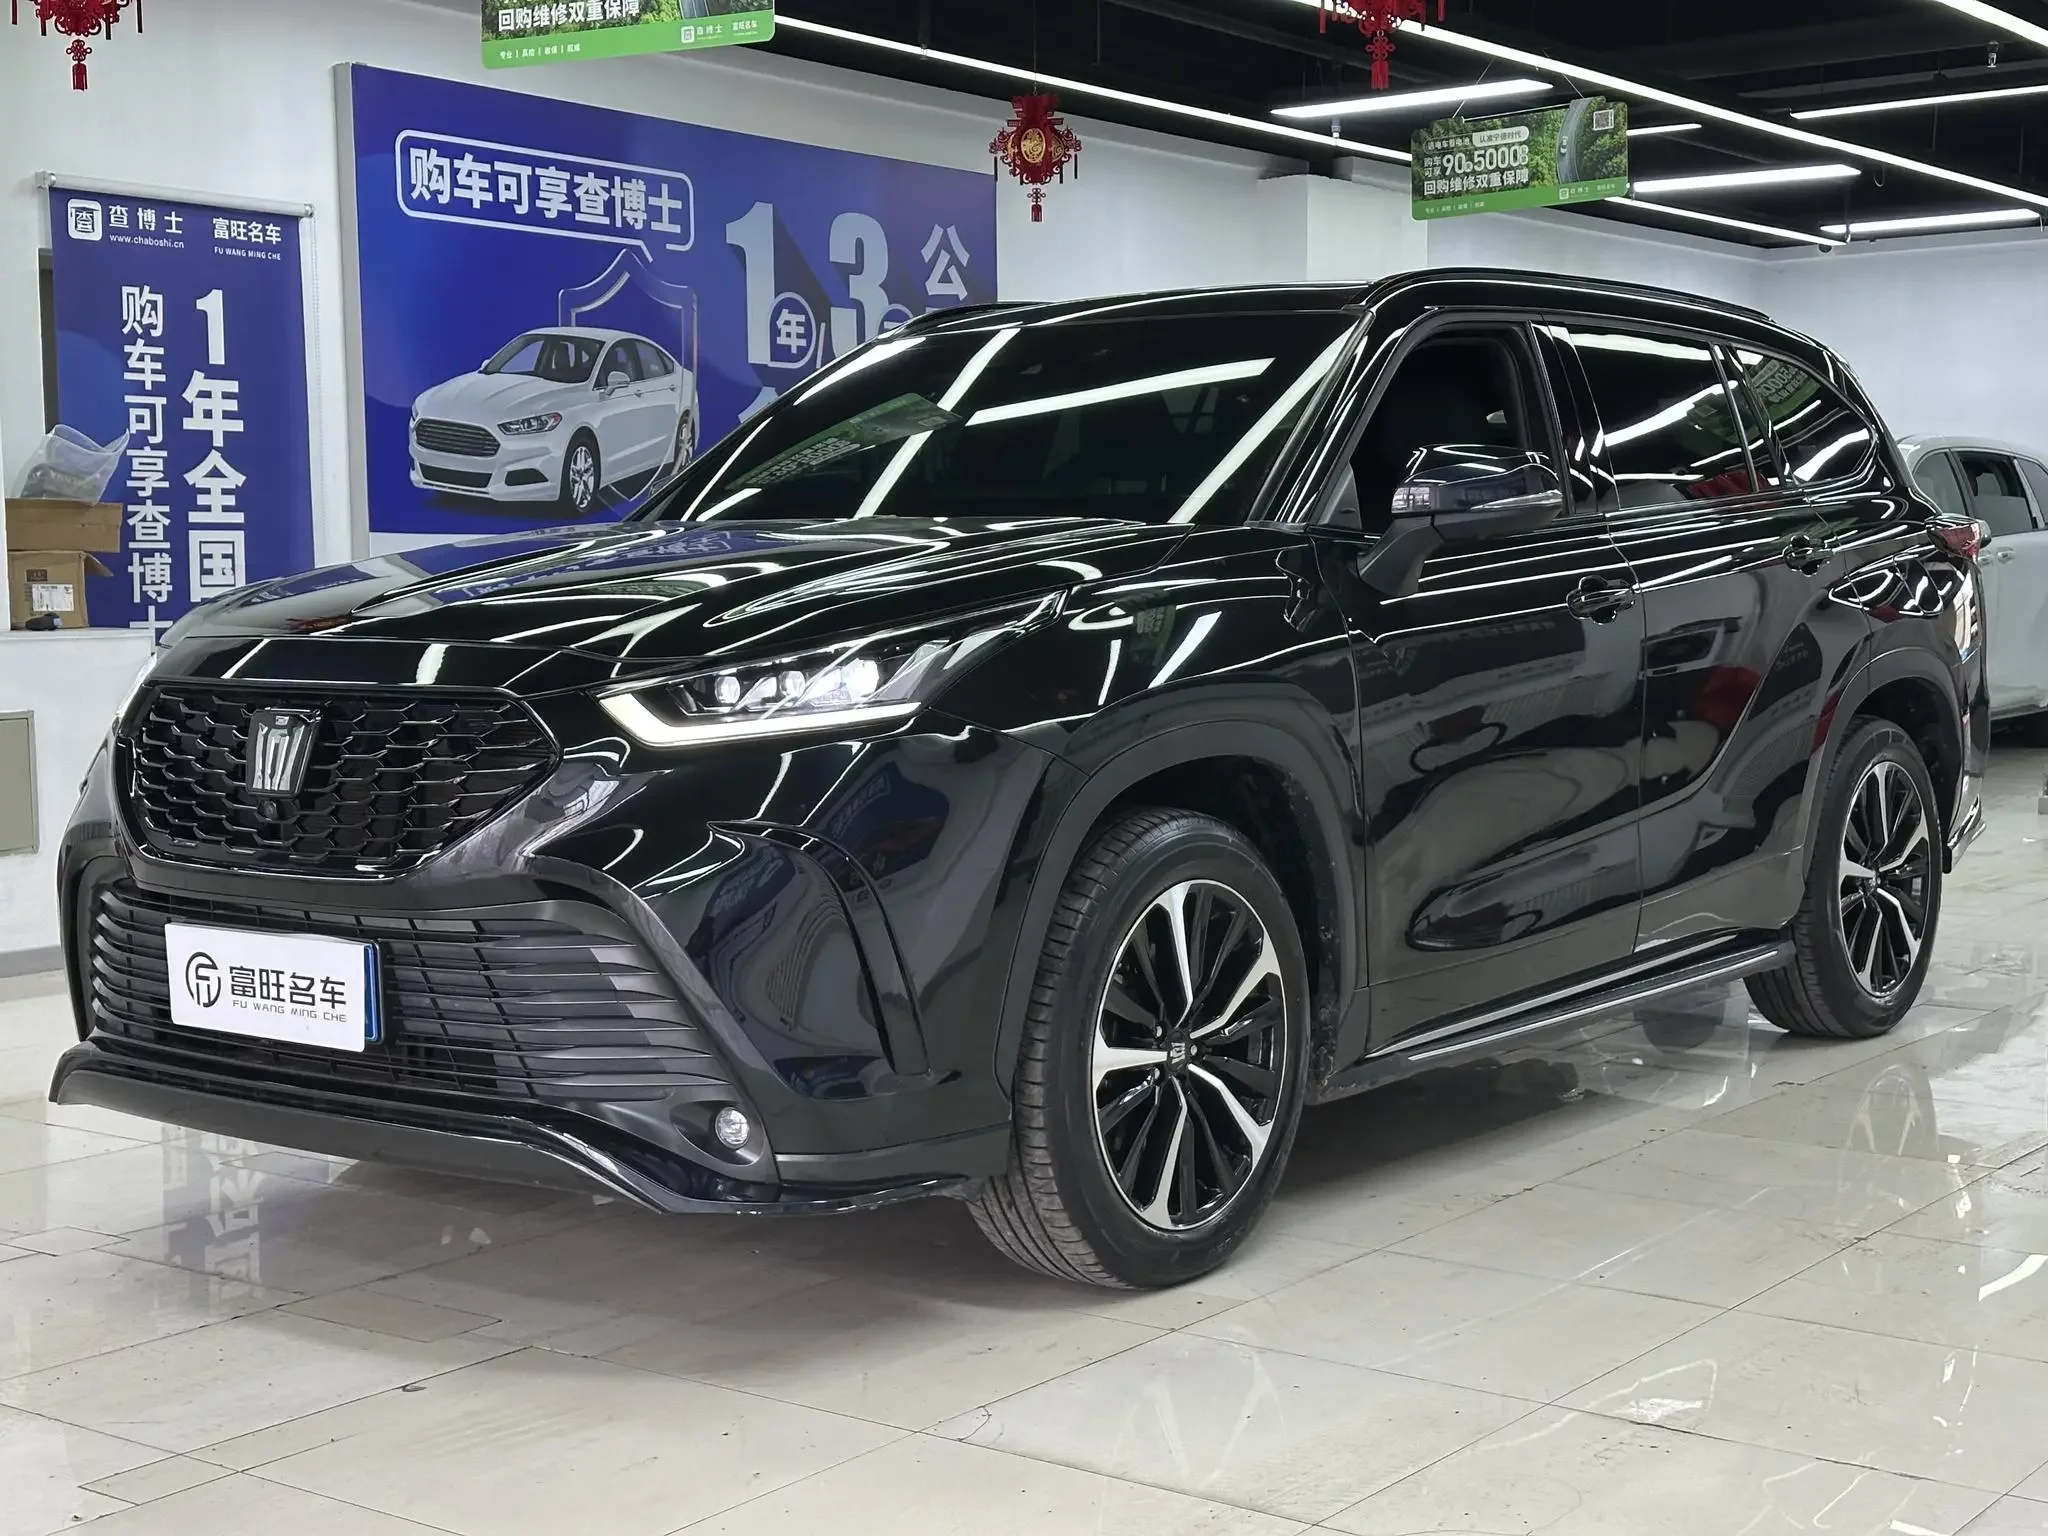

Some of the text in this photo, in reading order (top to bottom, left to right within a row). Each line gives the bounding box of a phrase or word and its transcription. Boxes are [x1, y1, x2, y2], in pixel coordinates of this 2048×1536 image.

[498, 0, 640, 31] 回购维修双重保障
[409, 147, 683, 234] 购车可享查博士
[1424, 168, 1529, 196] 回购维修双重保障
[108, 204, 184, 235] 查博士
[212, 217, 282, 245] 富旺名车
[109, 233, 185, 249] www.chaboshi.cn
[214, 246, 281, 261] FU WANG MING CHE
[182, 288, 247, 603] 1年全国
[120, 284, 174, 651] 购车可享查博士
[229, 965, 347, 1010] 富旺名车
[232, 999, 347, 1023] FU WANG MING CHE
